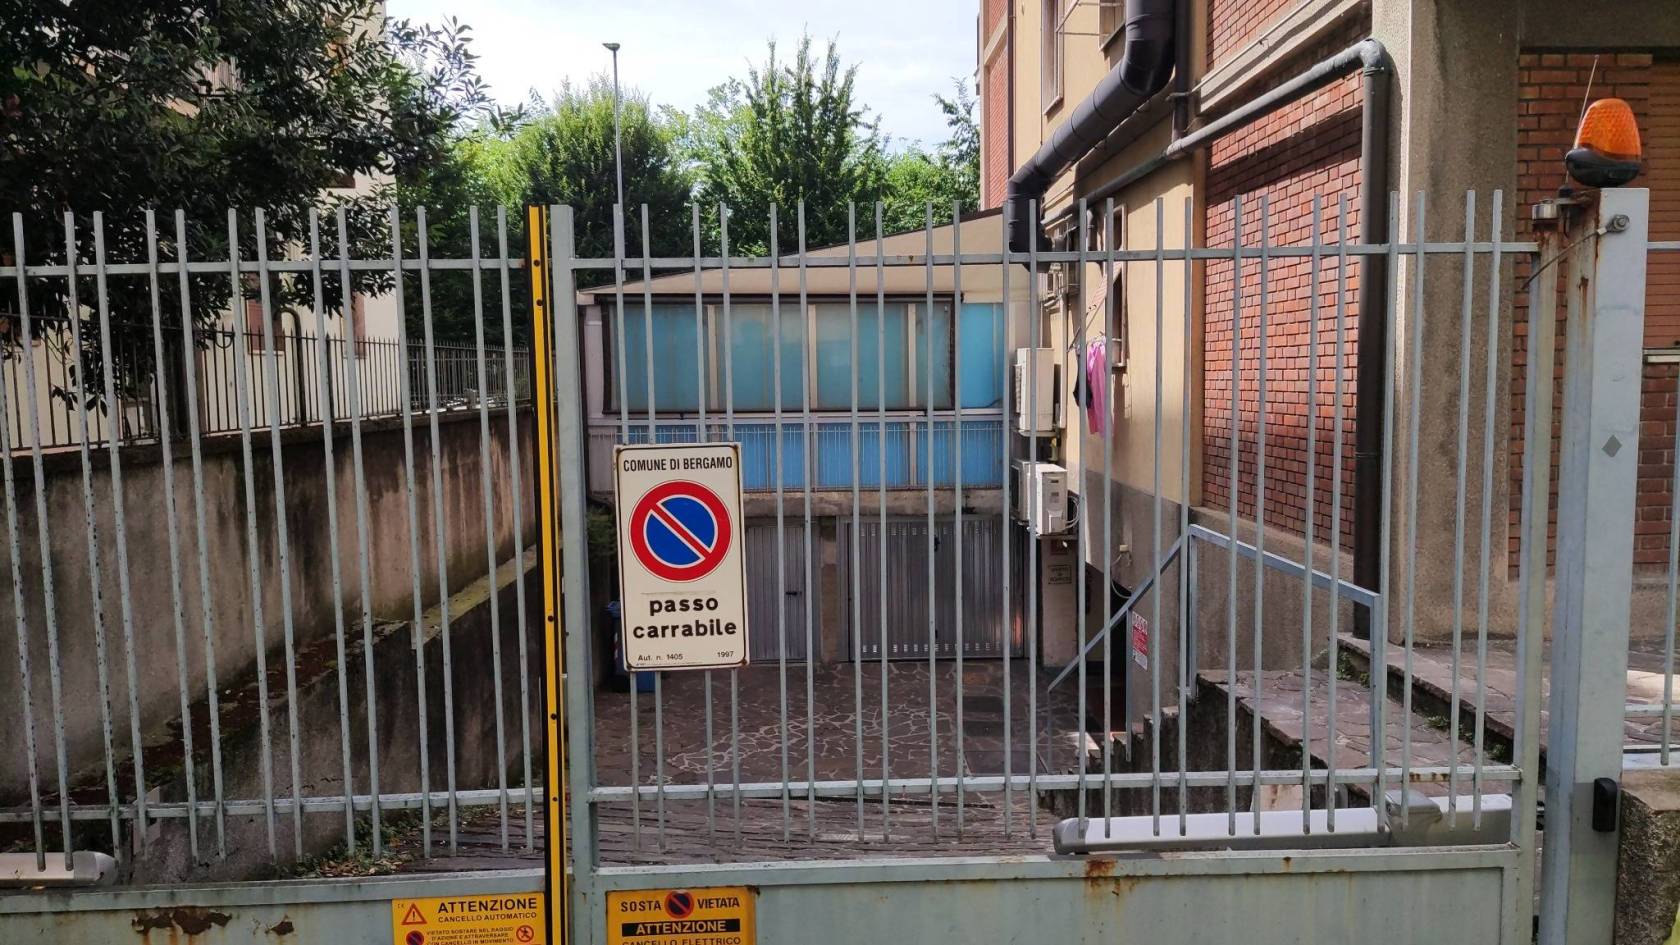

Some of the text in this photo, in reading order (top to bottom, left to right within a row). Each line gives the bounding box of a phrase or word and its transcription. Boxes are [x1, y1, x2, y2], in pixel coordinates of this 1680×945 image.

[623, 456, 733, 472] COMUNE DI BERGAMO
[649, 597, 719, 616] passo
[633, 619, 737, 639] carrabile
[438, 897, 537, 913] ATTENZIONE
[620, 897, 740, 912] SOSTA VIETATA
[438, 912, 537, 923] CANCELLO AUTOMATICO
[635, 920, 726, 935] ATTENZIONE
[682, 936, 741, 945] ELETTRICO
